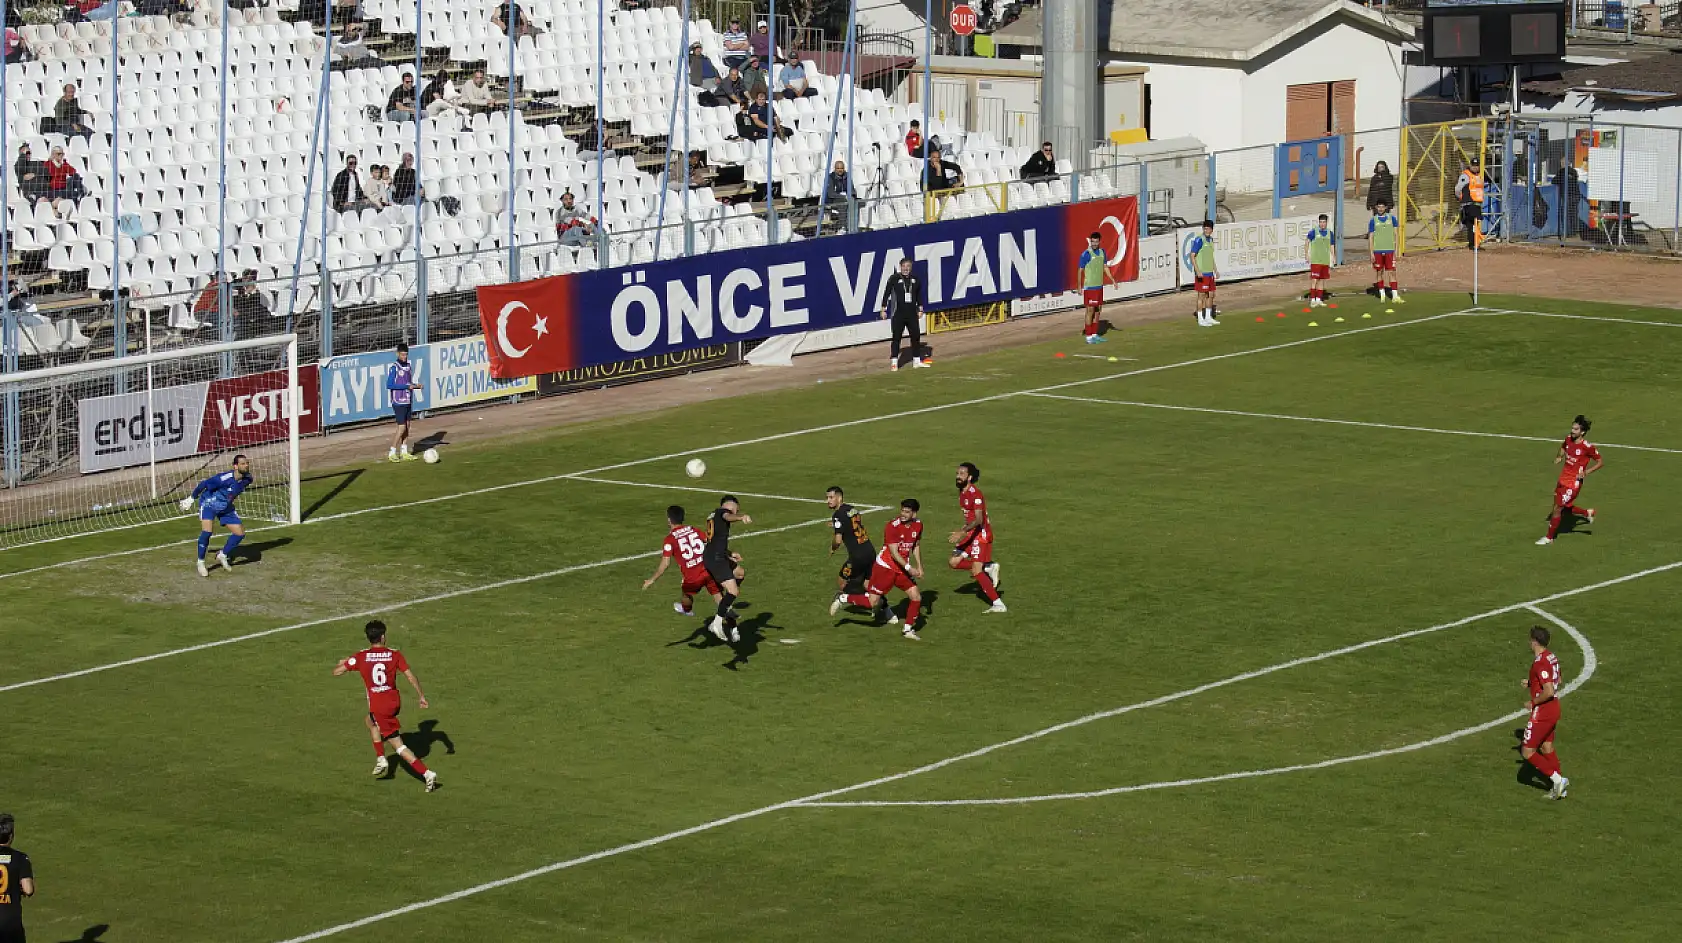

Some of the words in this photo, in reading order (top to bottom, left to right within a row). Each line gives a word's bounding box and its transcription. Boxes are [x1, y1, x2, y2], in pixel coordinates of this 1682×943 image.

[952, 13, 975, 27] DUR
[610, 260, 810, 352] ÖNCE
[827, 228, 1039, 317] VATAN
[439, 340, 490, 371] PAZAR
[653, 343, 728, 369] HOMES
[329, 357, 424, 417] AYTK
[435, 371, 469, 401] YAPI
[94, 405, 184, 446] erday
[677, 531, 705, 560] 55
[372, 663, 387, 686] 6
